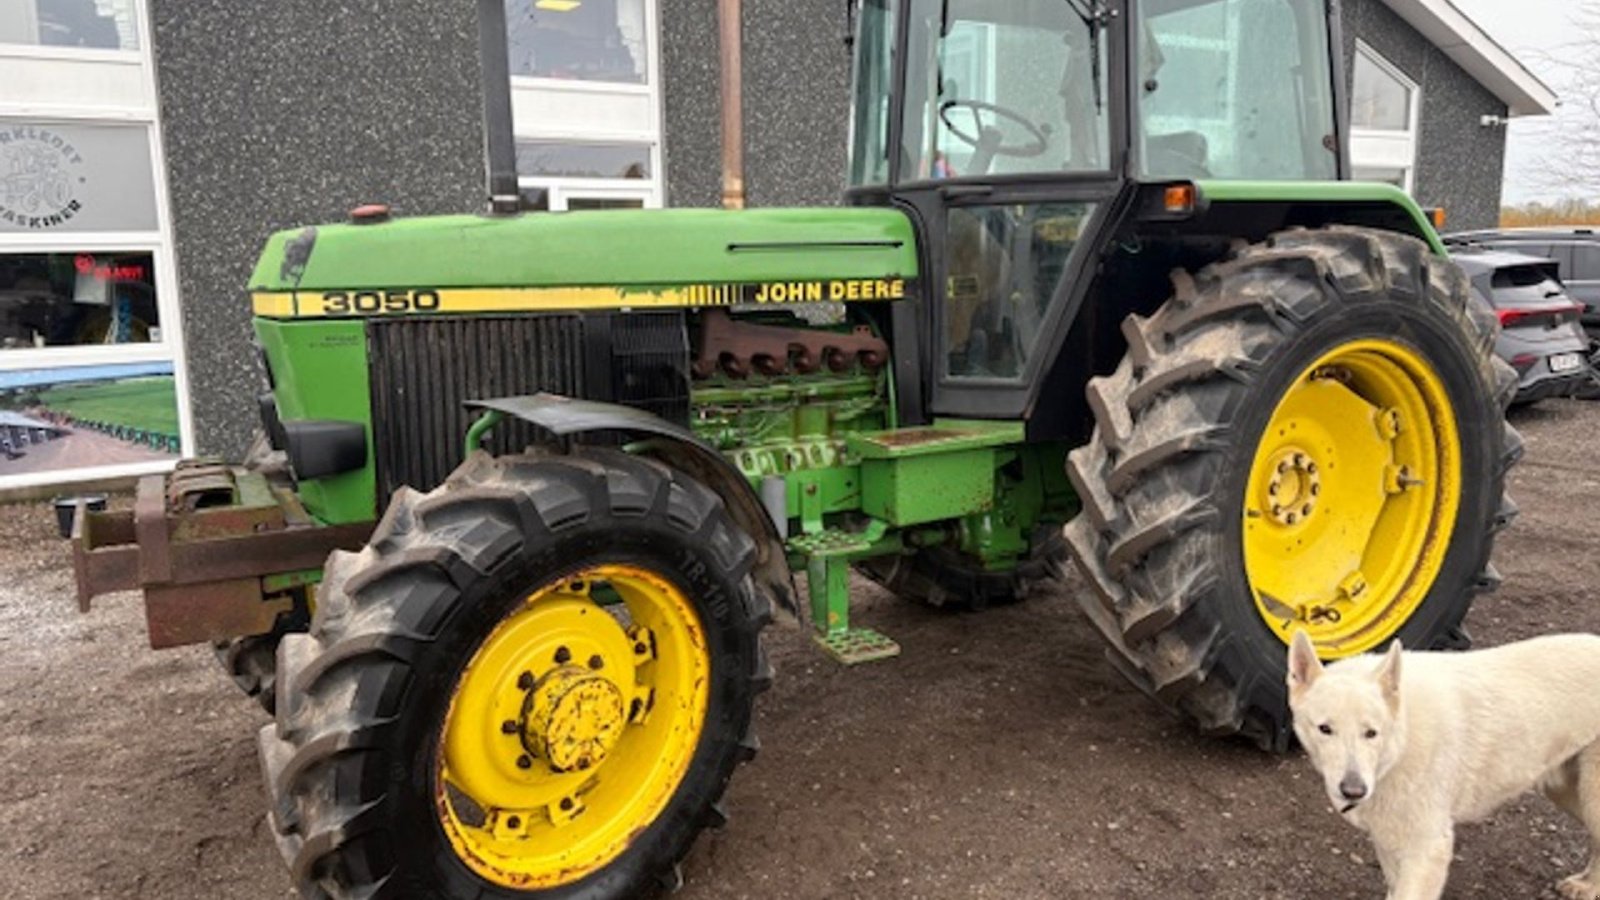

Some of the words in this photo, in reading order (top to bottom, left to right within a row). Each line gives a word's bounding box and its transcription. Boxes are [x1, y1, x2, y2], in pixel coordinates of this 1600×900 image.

[322, 288, 440, 315] 3050
[755, 281, 822, 303] JOHN
[829, 279, 905, 301] DEERE
